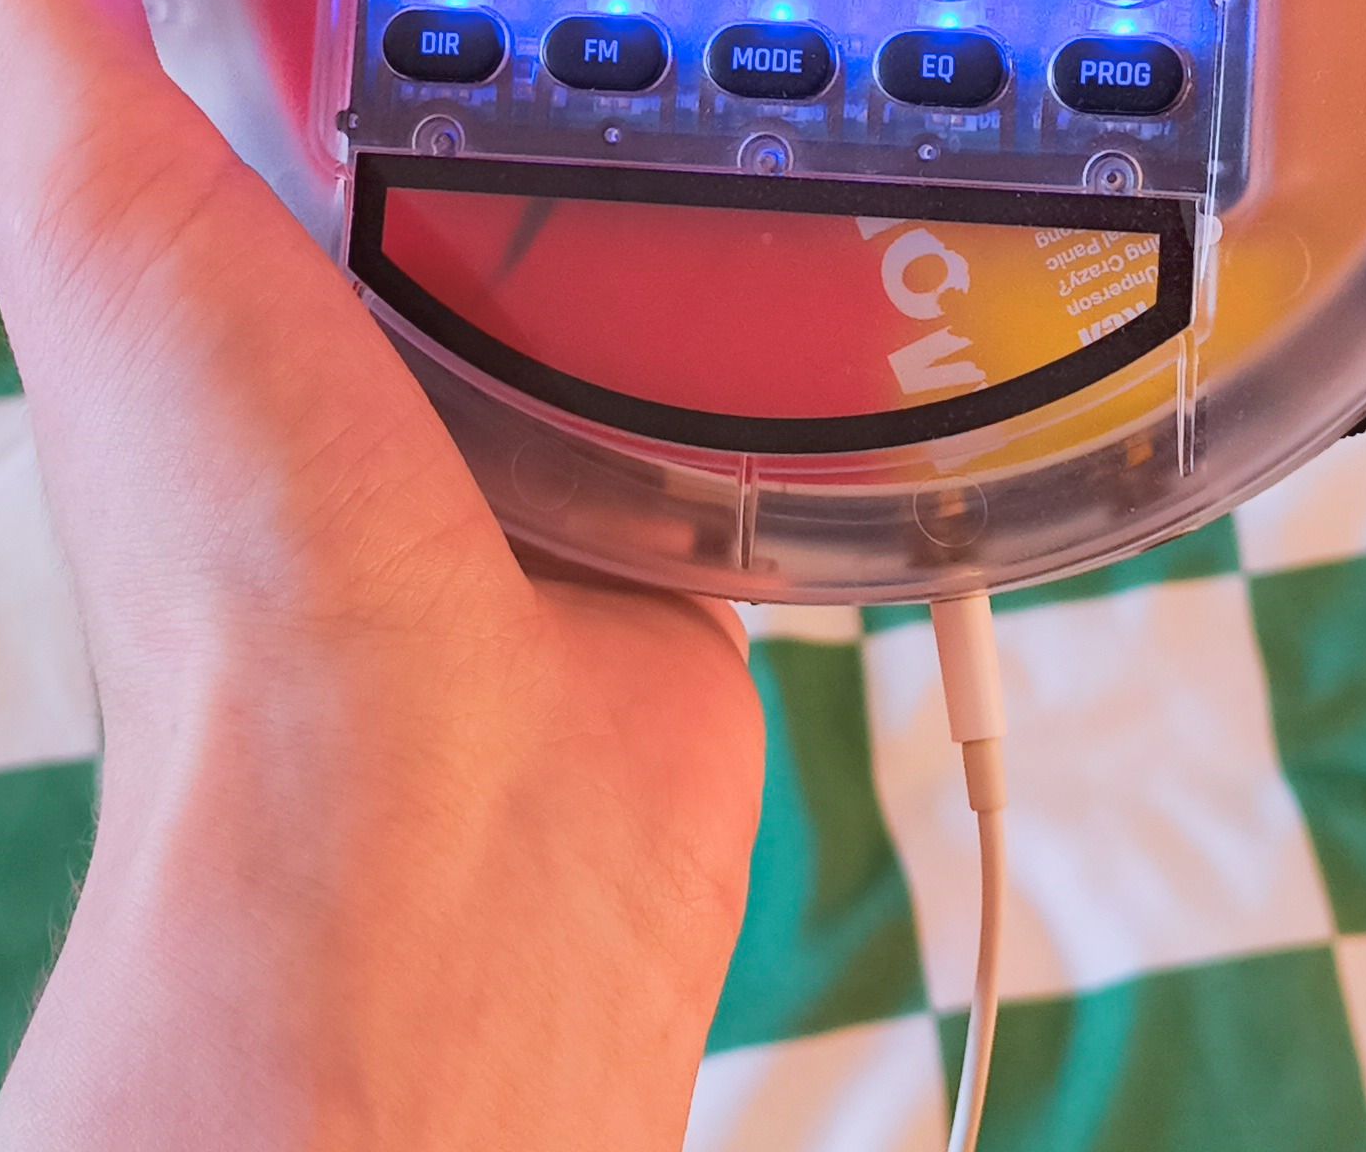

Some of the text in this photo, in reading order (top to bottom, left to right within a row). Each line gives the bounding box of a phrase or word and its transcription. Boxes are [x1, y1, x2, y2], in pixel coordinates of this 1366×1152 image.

[421, 31, 460, 56] DIR
[584, 38, 619, 64] FM
[731, 47, 804, 74] MODE
[921, 53, 956, 84] EQ
[1080, 59, 1152, 88] PROG
[1045, 237, 1102, 271] Panic
[1059, 254, 1125, 297] Crazy?
[1066, 265, 1159, 317] Unperson
